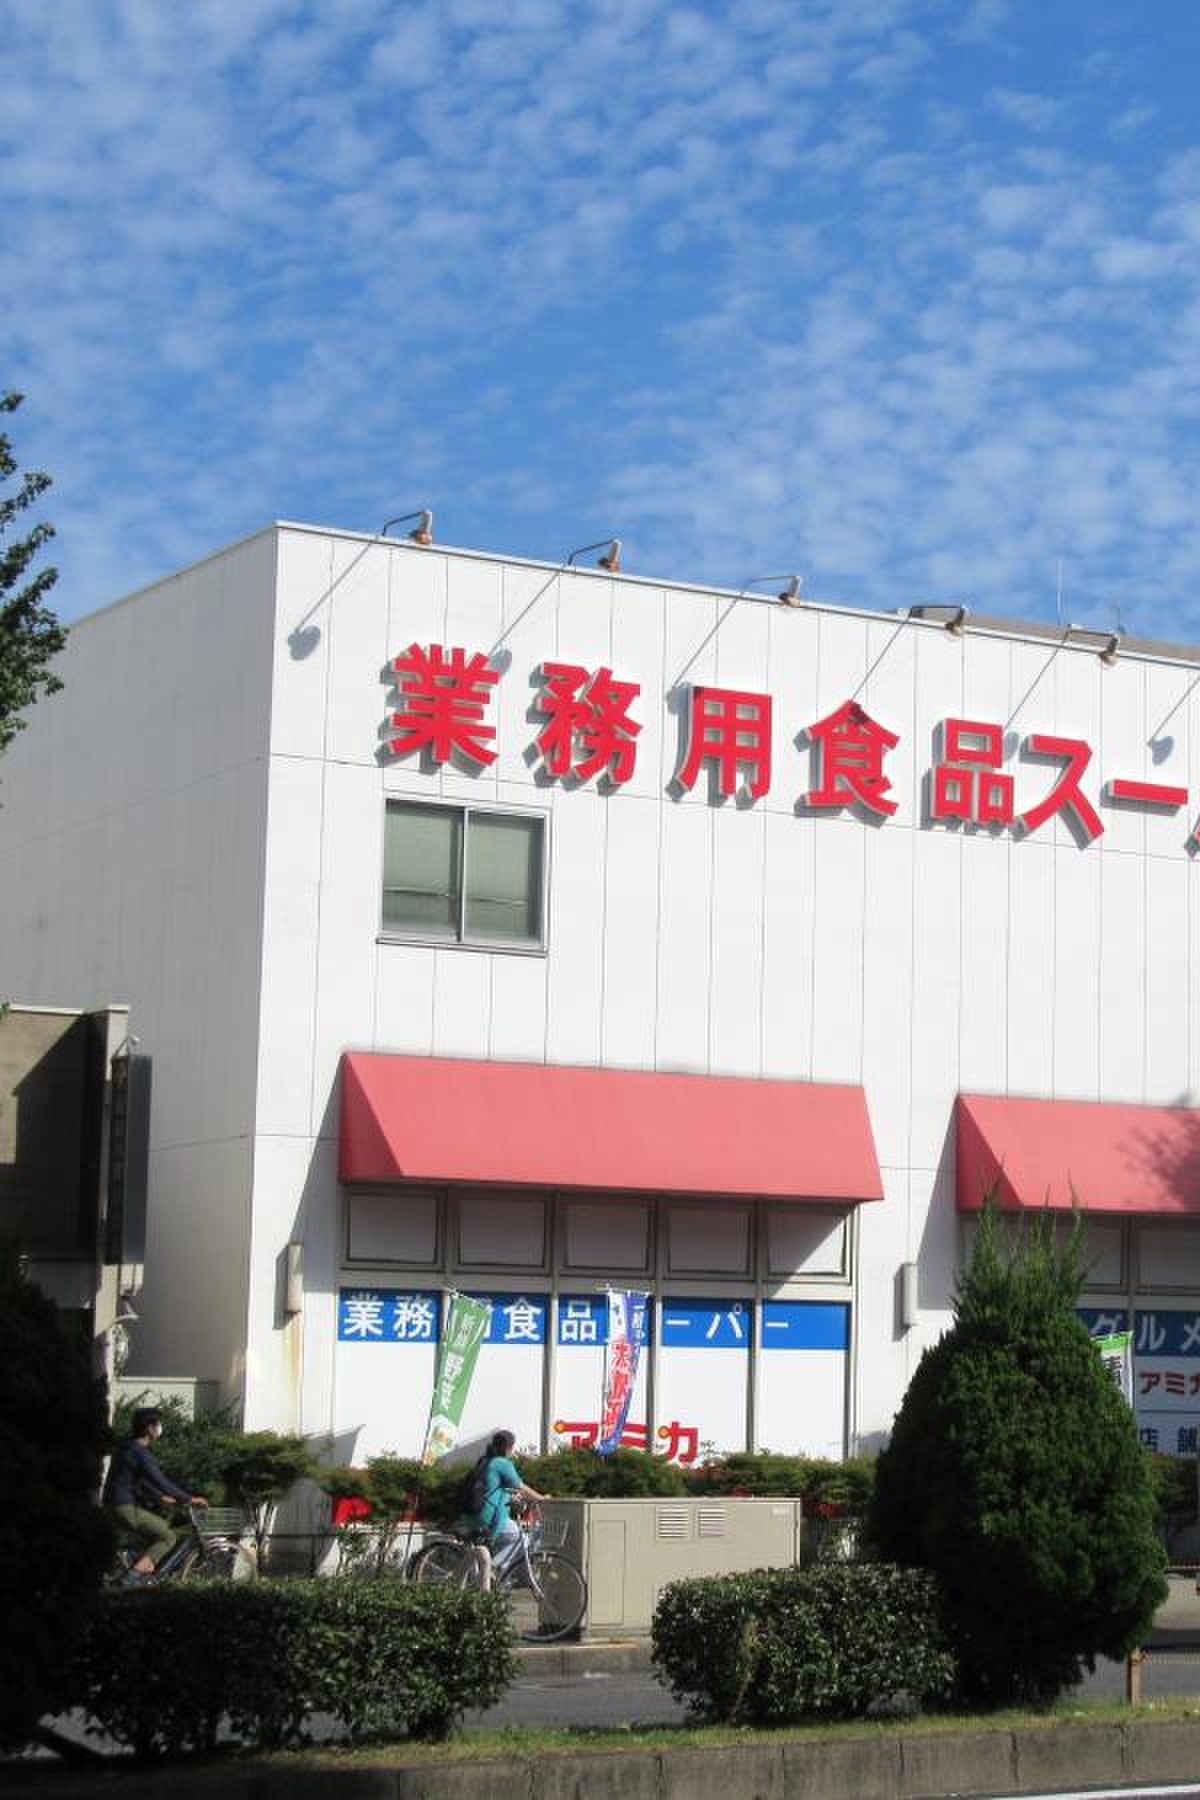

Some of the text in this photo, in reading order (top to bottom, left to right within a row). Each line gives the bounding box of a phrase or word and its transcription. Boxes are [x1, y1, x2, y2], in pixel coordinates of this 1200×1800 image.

[343, 1294, 790, 1341] 業務食品ーパー
